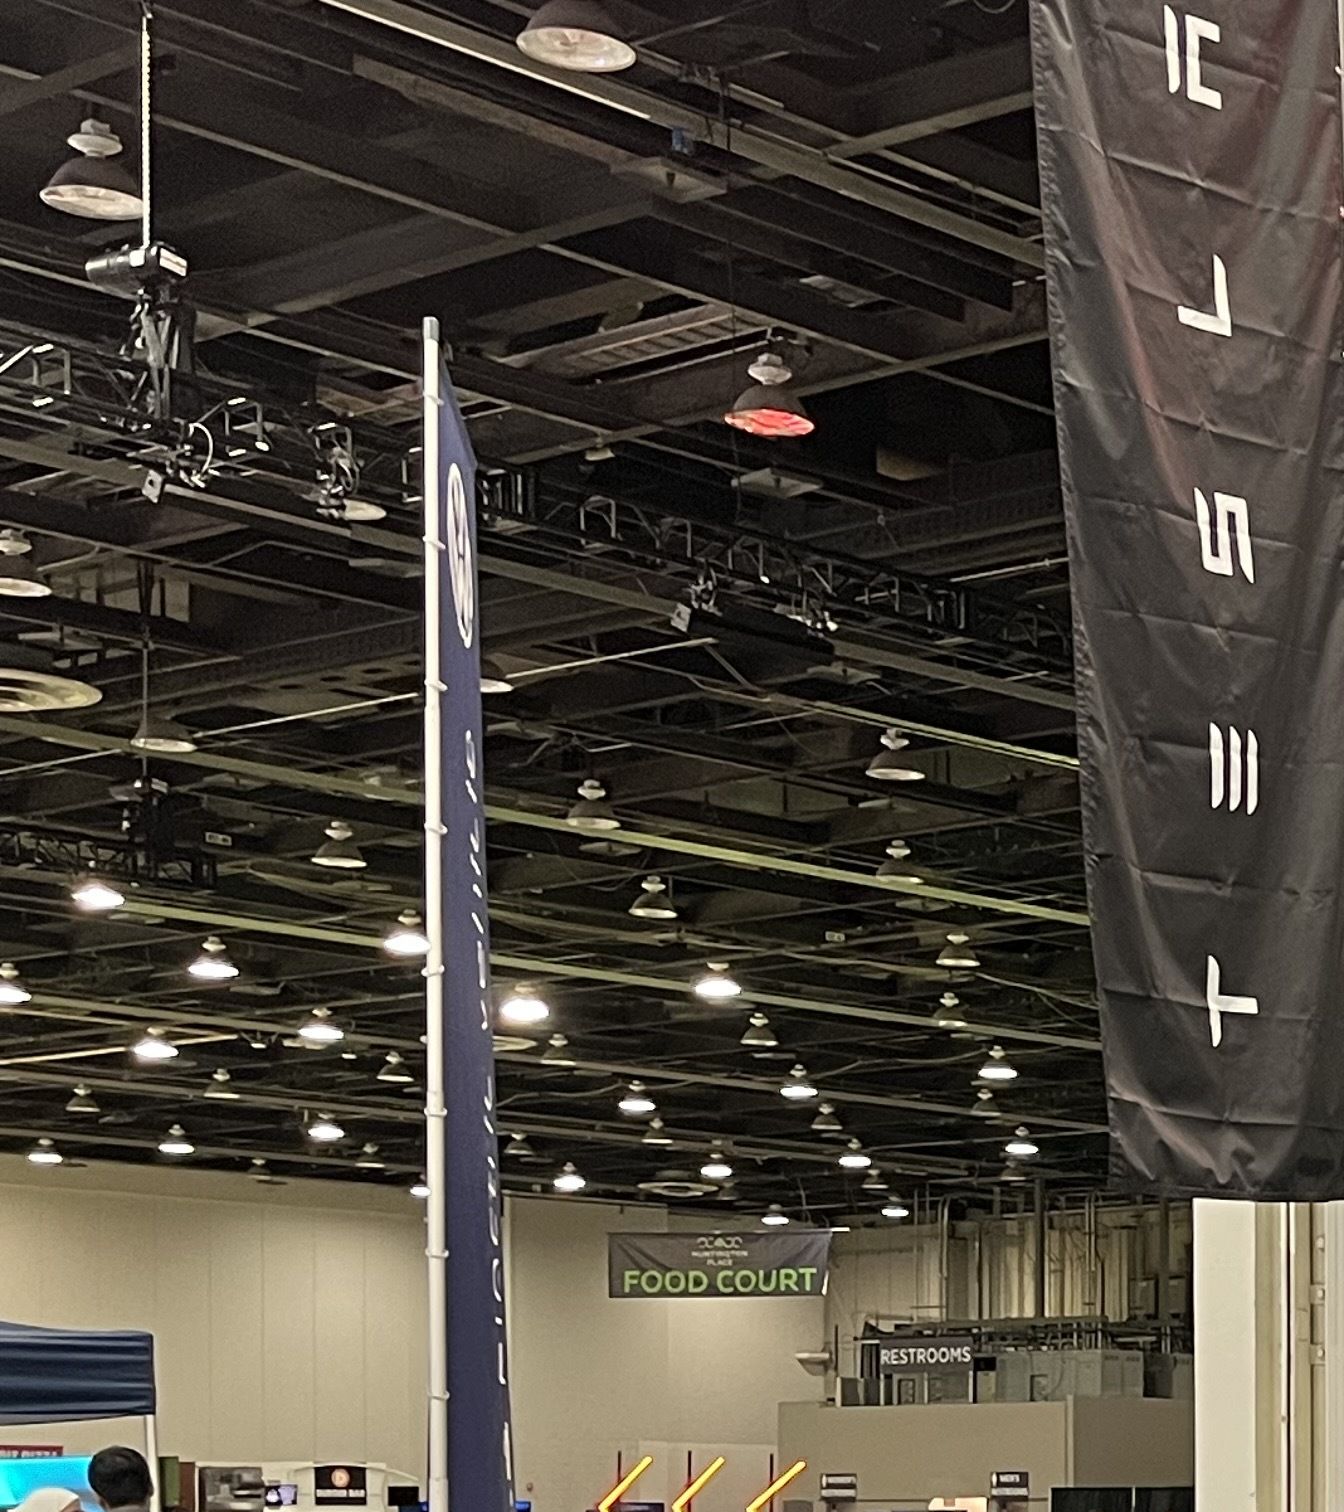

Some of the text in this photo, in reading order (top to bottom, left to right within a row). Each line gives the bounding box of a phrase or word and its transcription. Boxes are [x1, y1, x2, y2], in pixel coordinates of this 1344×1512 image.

[1163, 4, 1258, 1048] TESLA
[623, 1267, 817, 1294] FOOD COURT
[880, 1346, 971, 1365] RESTROOMS
